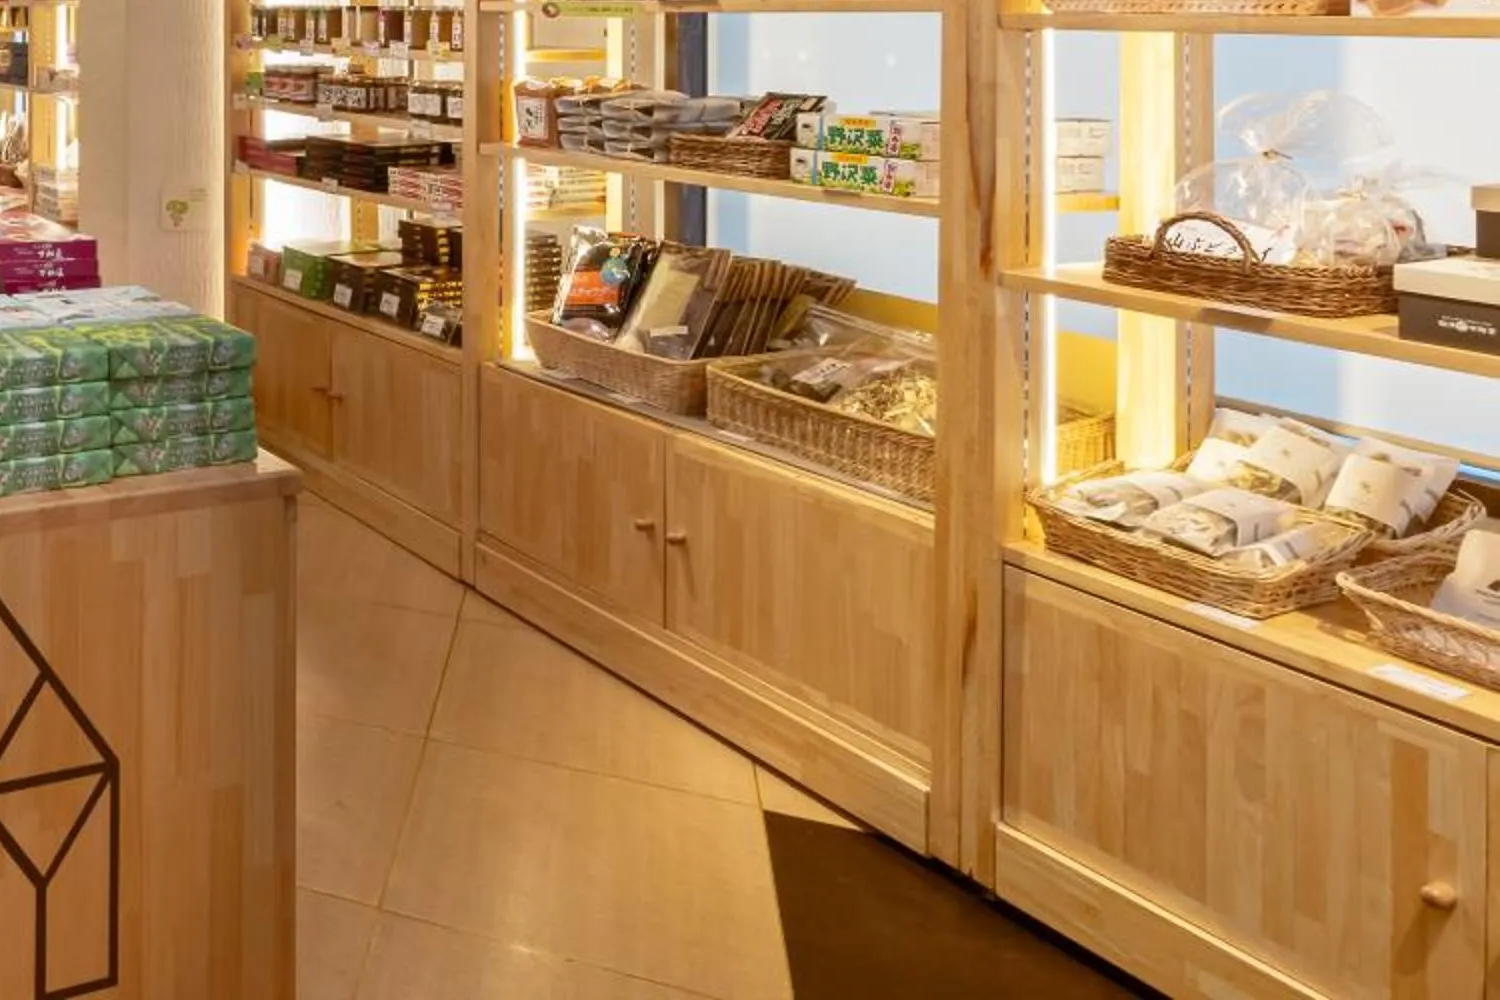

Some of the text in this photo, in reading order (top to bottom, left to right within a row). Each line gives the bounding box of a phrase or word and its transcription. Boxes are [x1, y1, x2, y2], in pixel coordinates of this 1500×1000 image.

[827, 124, 884, 149] 野沢菜
[821, 160, 878, 185] 野沢菜
